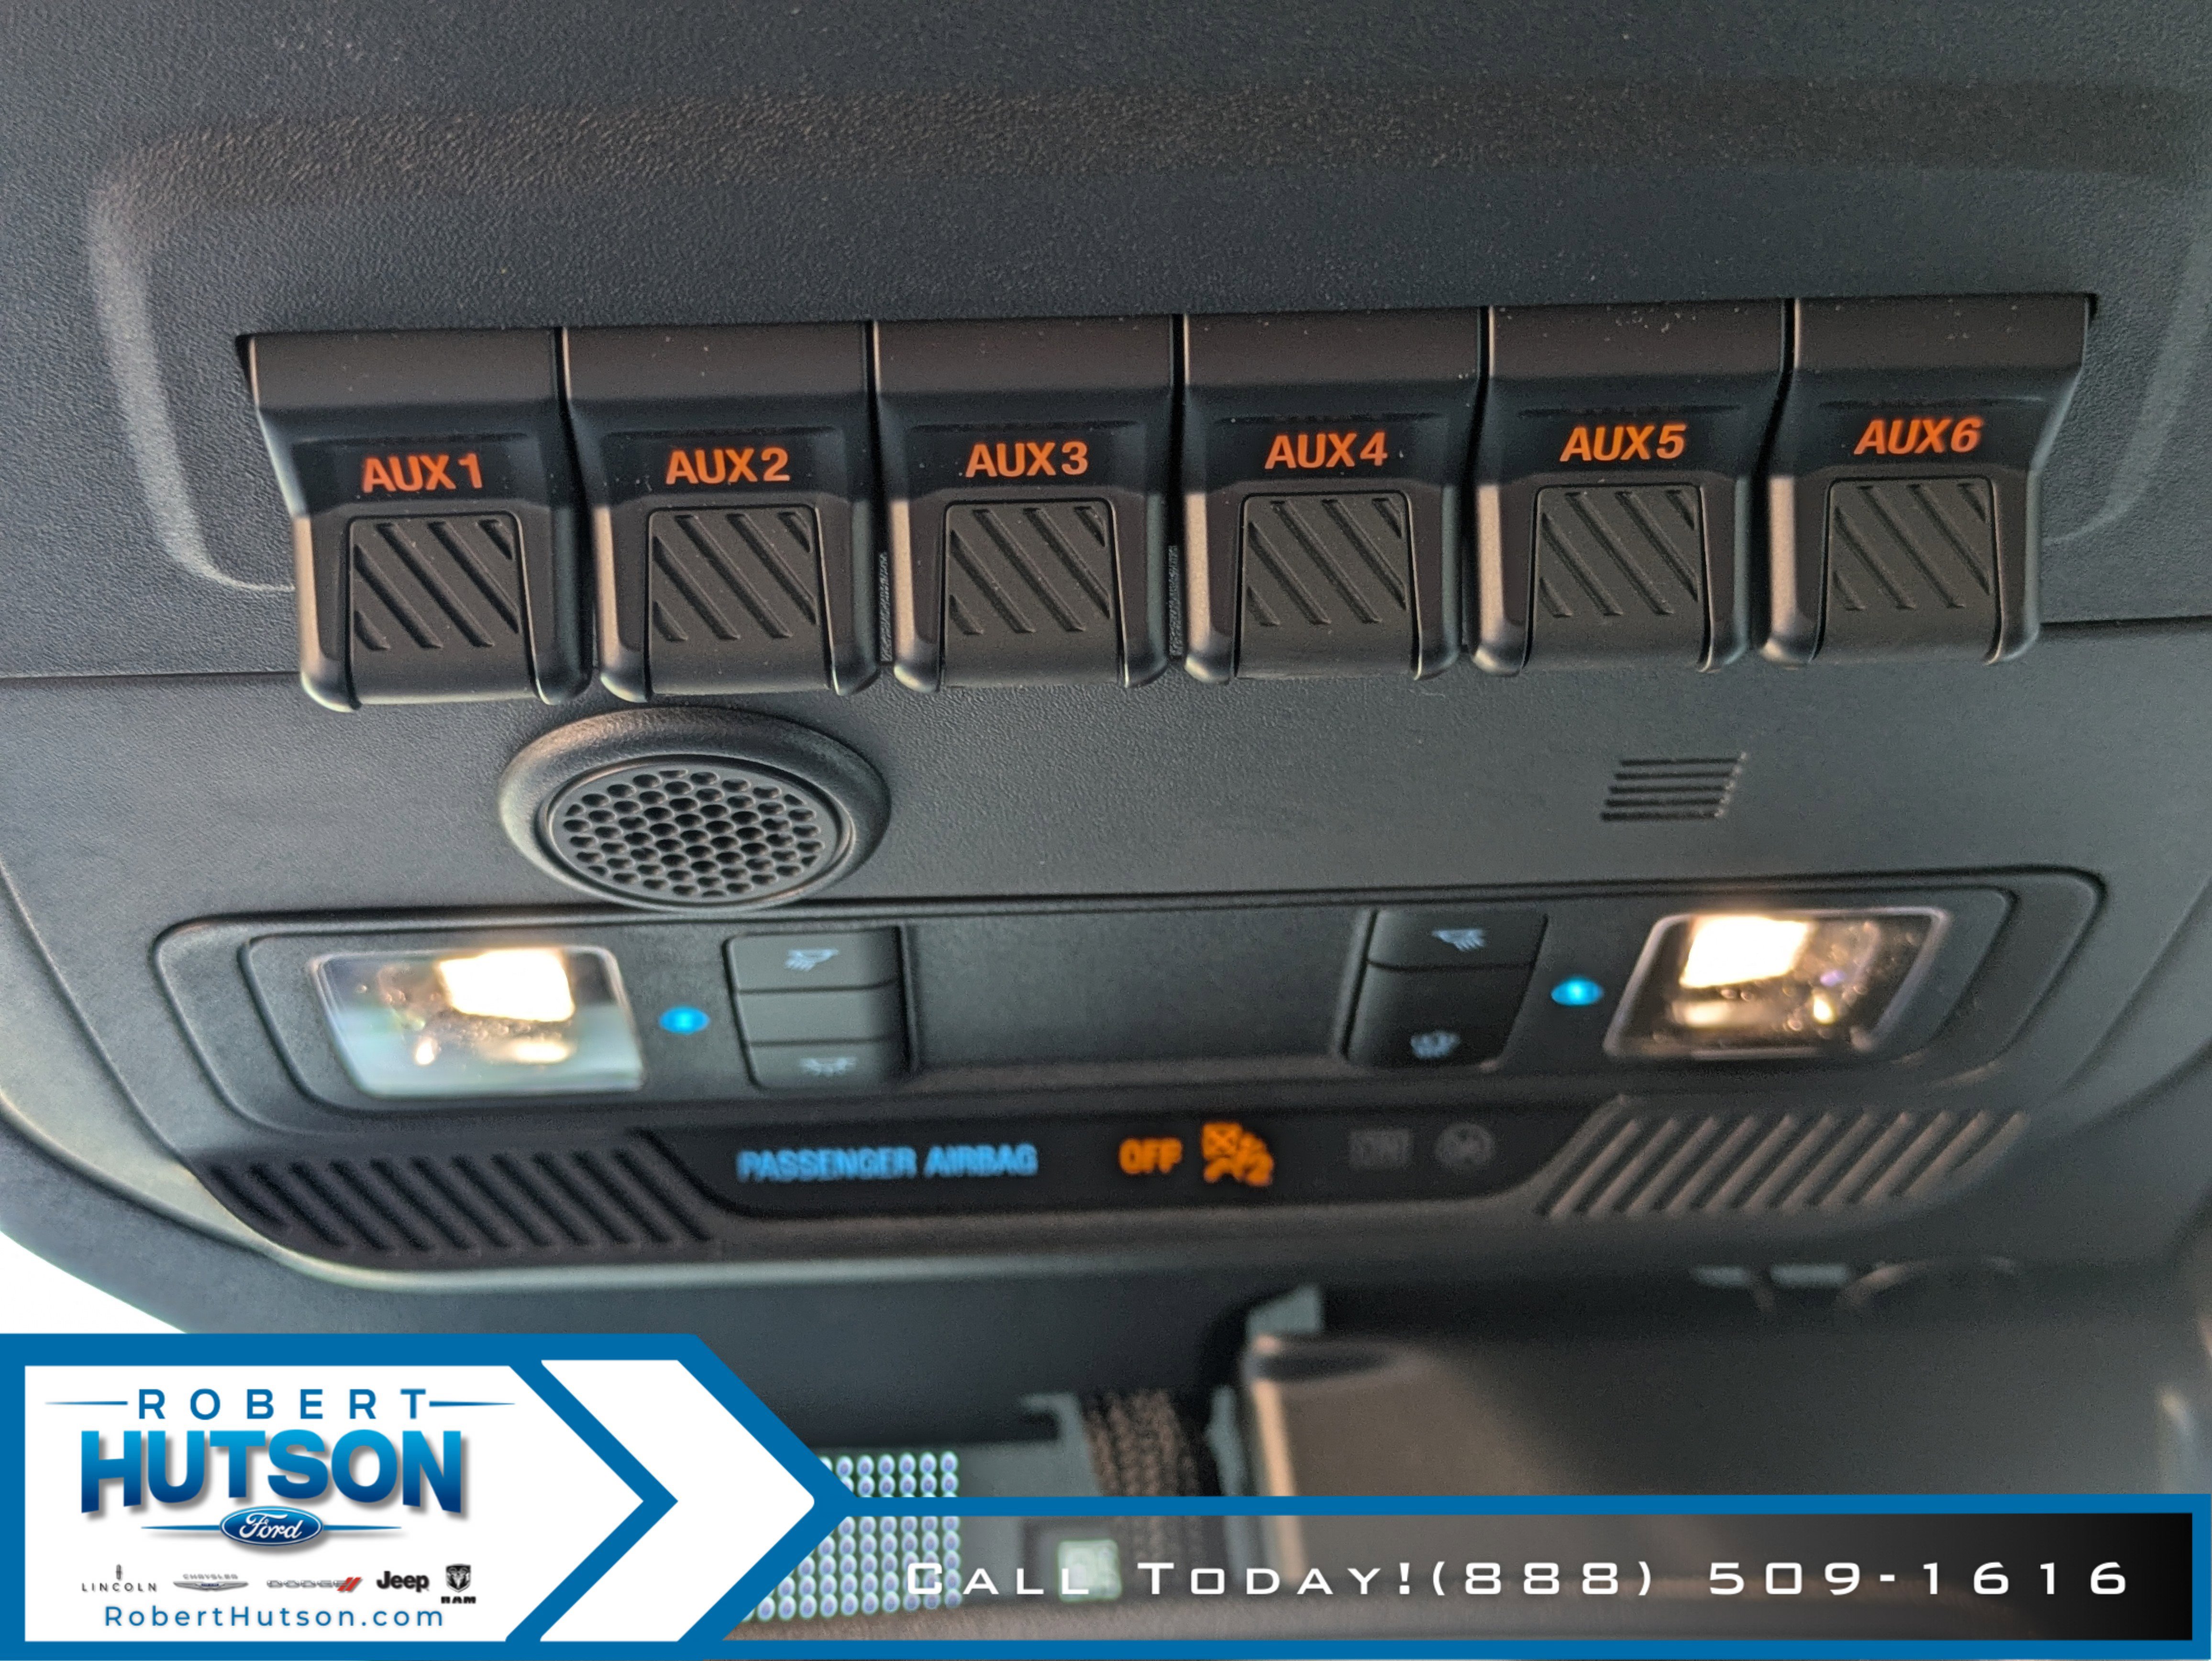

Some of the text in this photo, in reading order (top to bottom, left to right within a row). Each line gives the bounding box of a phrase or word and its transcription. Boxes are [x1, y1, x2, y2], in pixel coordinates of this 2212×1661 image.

[736, 1137, 1183, 1182] PASSENGER AIRBAG OFF
